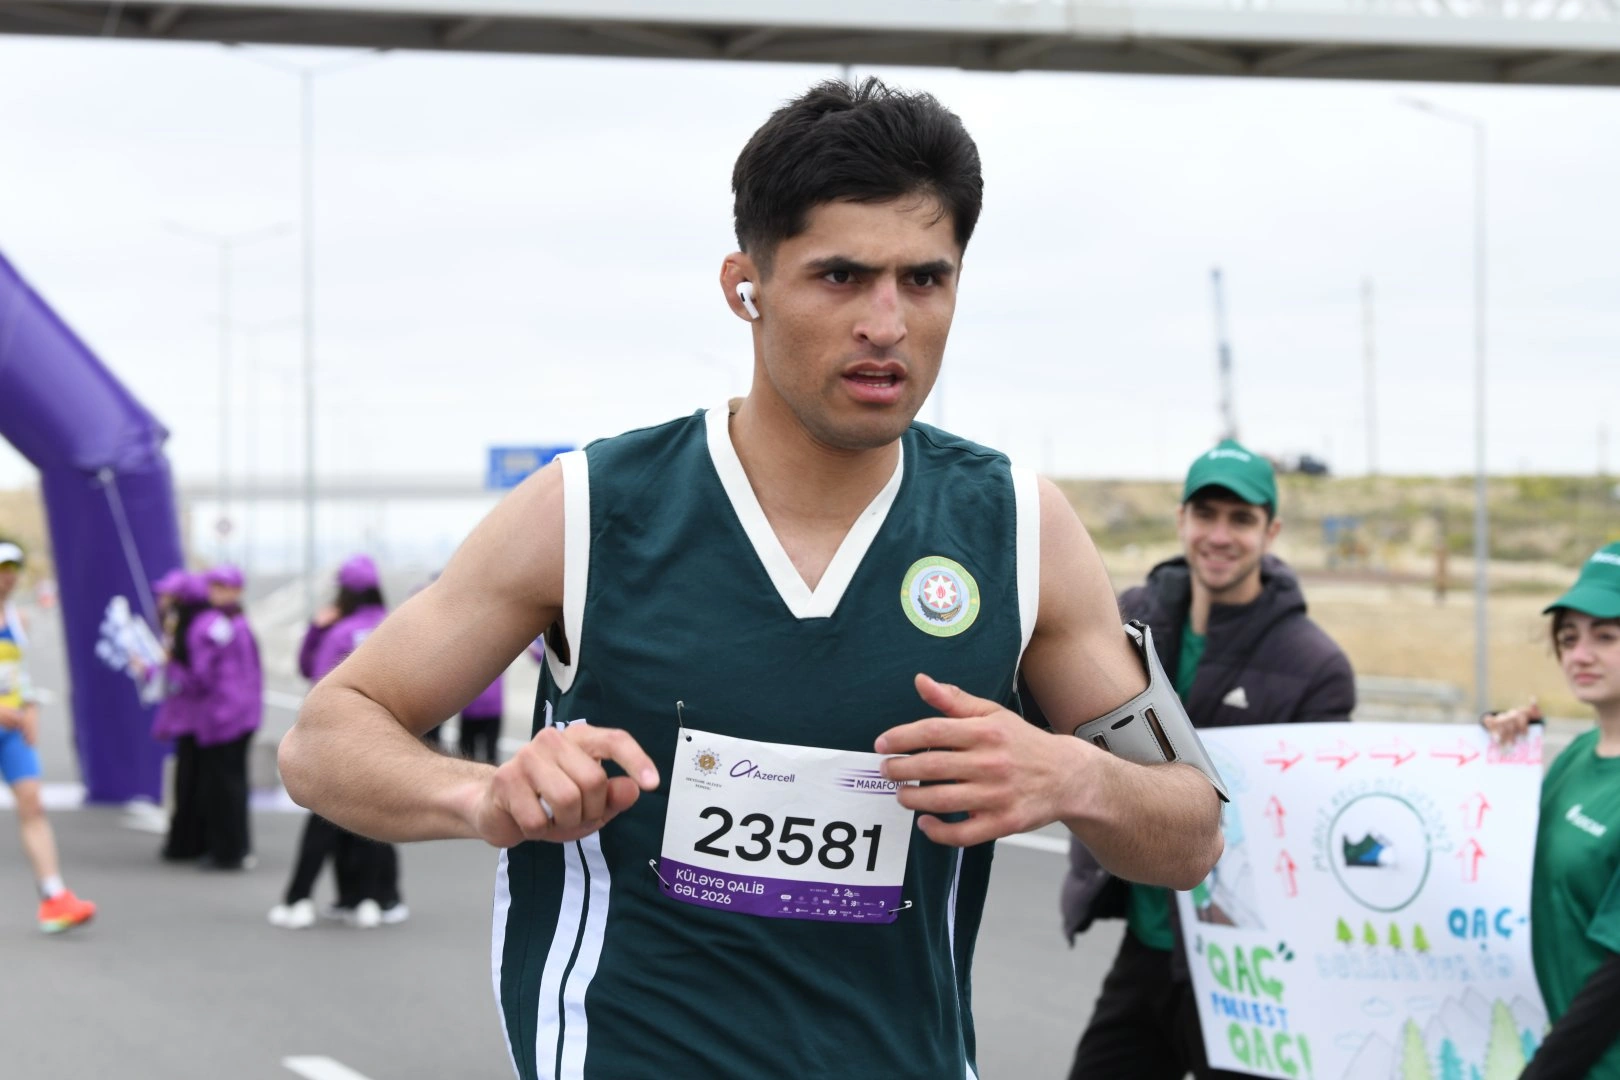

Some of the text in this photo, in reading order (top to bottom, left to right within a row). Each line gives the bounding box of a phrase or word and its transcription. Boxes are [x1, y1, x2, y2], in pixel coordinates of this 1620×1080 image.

[752, 770, 796, 783] Azercell
[693, 805, 882, 873] 23581
[675, 868, 765, 895] KÜLƏYƏ QALİB
[673, 883, 732, 906] GƏL 2026
